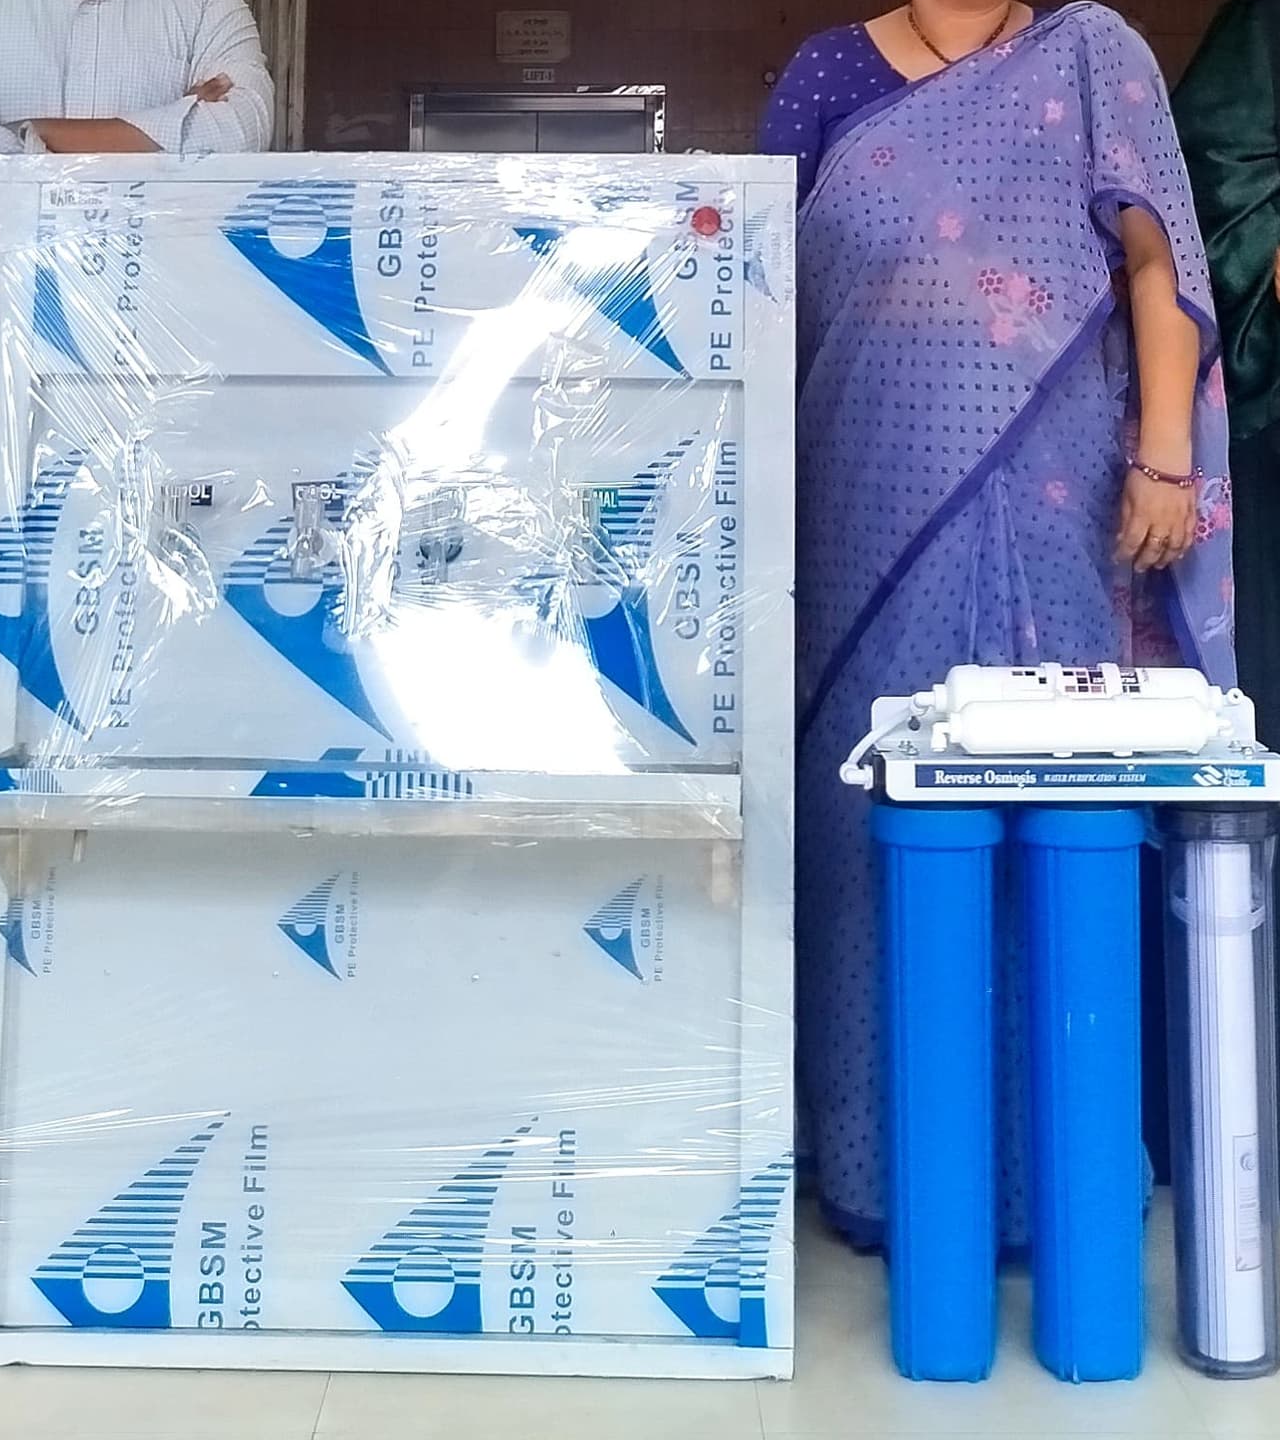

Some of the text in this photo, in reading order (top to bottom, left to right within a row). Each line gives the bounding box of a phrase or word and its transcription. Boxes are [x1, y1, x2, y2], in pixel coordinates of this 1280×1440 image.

[412, 327, 435, 367] PE
[710, 332, 732, 371] PE
[715, 440, 738, 506] Film
[713, 693, 736, 734] PE
[934, 769, 983, 785] Reverse
[984, 769, 1038, 786] Osmosis
[31, 899, 42, 940] GBSM
[335, 904, 345, 945] GBSM
[348, 898, 359, 958] Protective
[640, 907, 651, 948] GBSM
[654, 902, 664, 962] Protective
[43, 958, 54, 974] PE
[347, 963, 357, 978] PE
[654, 967, 664, 982] PE
[243, 1124, 269, 1194] Film
[551, 1129, 577, 1199] Film
[197, 1221, 228, 1329] GBSM
[508, 1226, 537, 1335] GBSM
